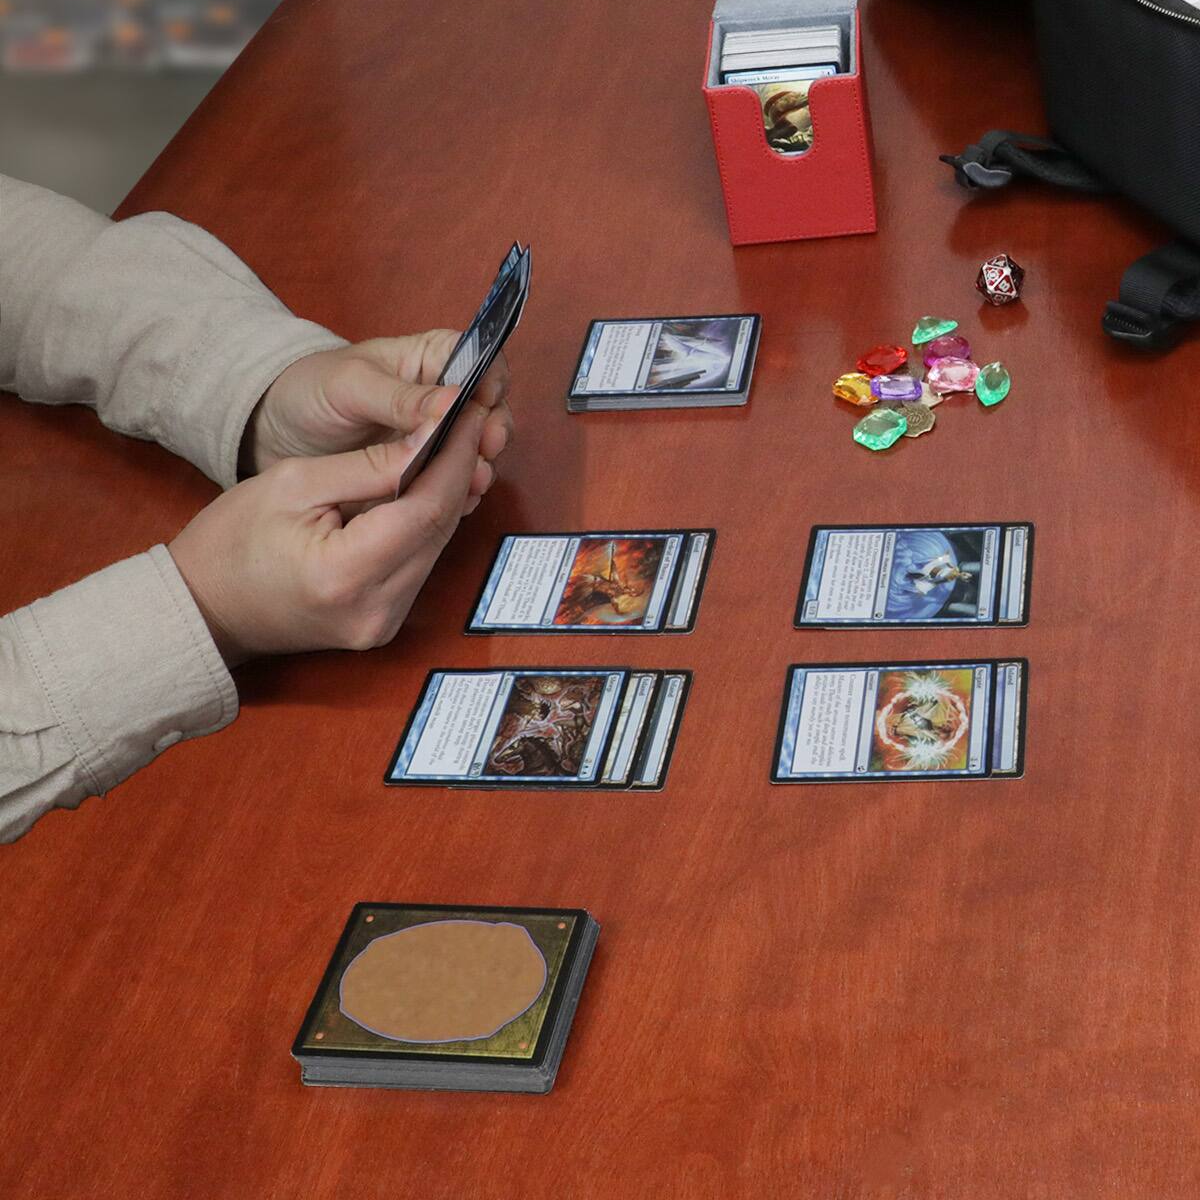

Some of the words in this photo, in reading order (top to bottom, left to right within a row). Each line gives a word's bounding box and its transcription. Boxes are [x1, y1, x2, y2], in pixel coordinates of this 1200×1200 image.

[983, 531, 994, 565] Omenspeaker
[605, 676, 617, 691] Sleep
[975, 669, 983, 688] Negate
[1007, 668, 1015, 685] Island
[639, 678, 649, 696] Island
[667, 679, 678, 697] Island
